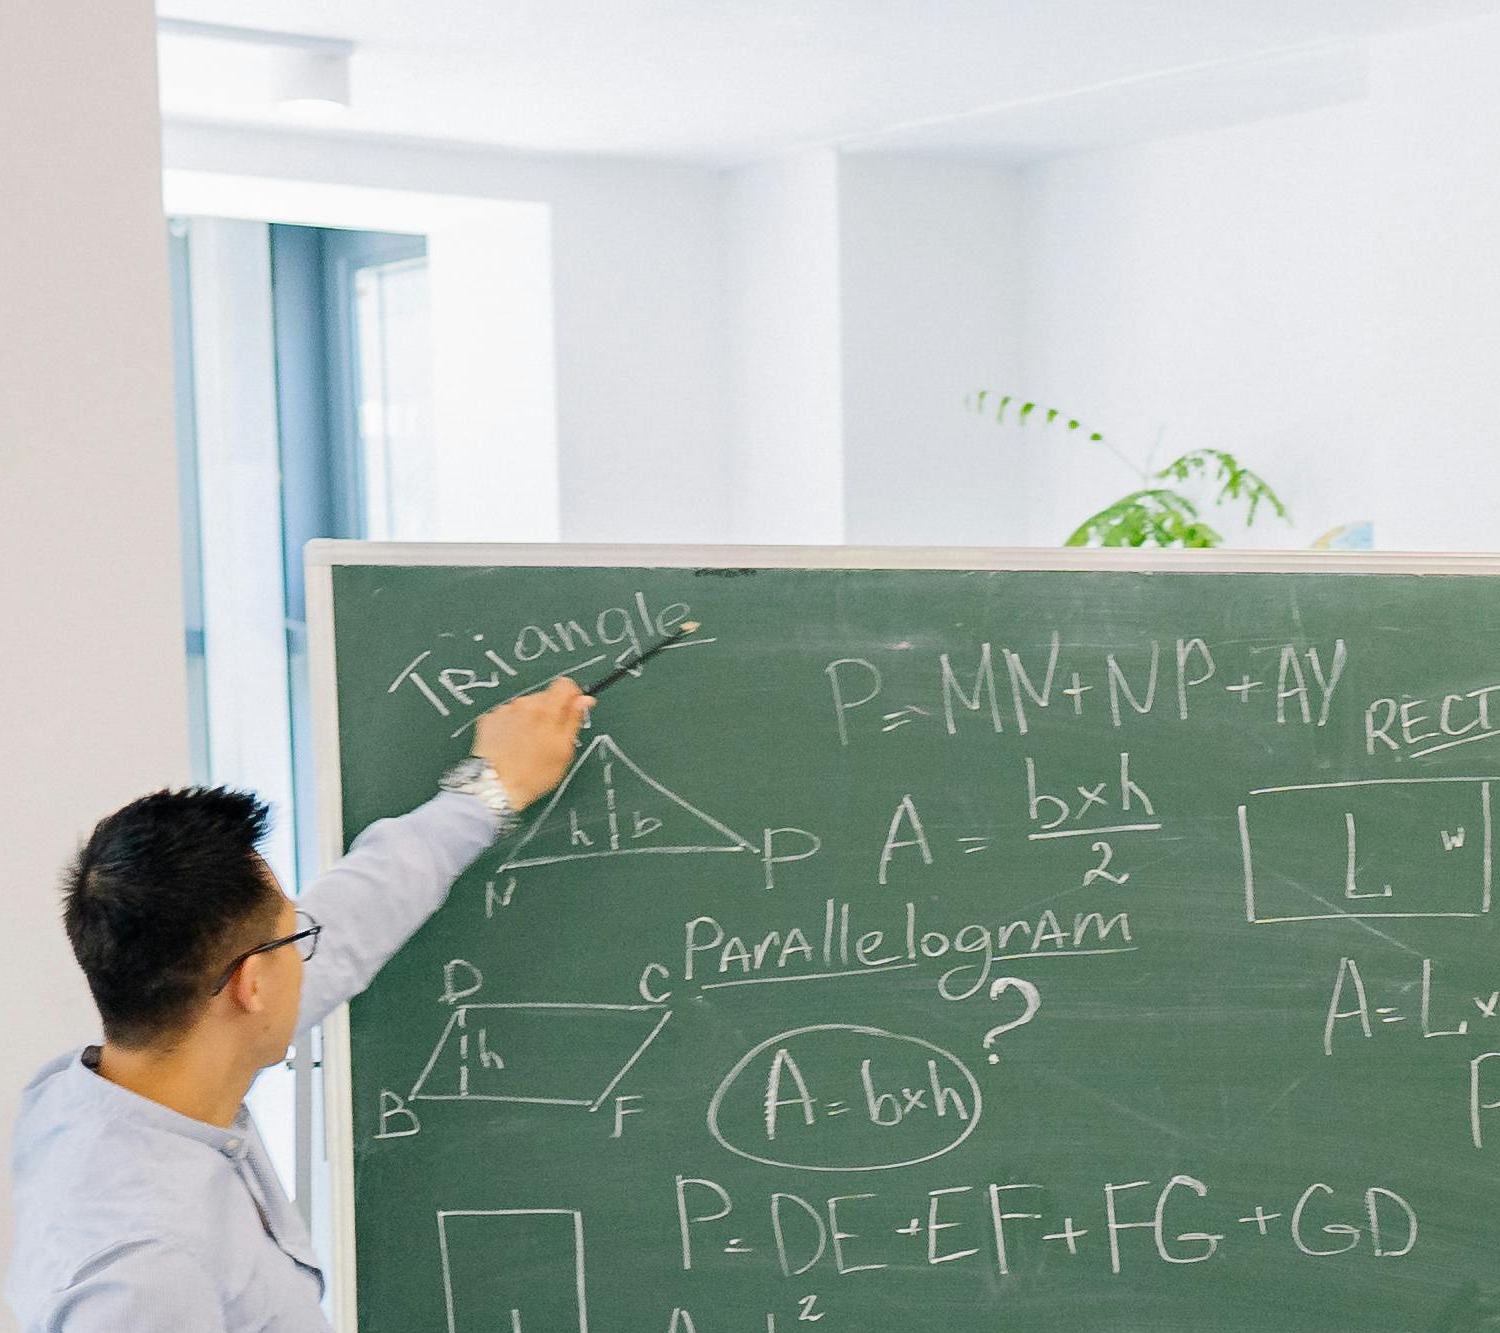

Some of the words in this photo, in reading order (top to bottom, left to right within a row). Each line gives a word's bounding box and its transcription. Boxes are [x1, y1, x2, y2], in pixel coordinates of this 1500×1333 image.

[761, 828, 821, 889] P
[1346, 813, 1393, 899] L
[439, 960, 483, 1004] D
[374, 1089, 420, 1139] B
[610, 1096, 644, 1138] F
